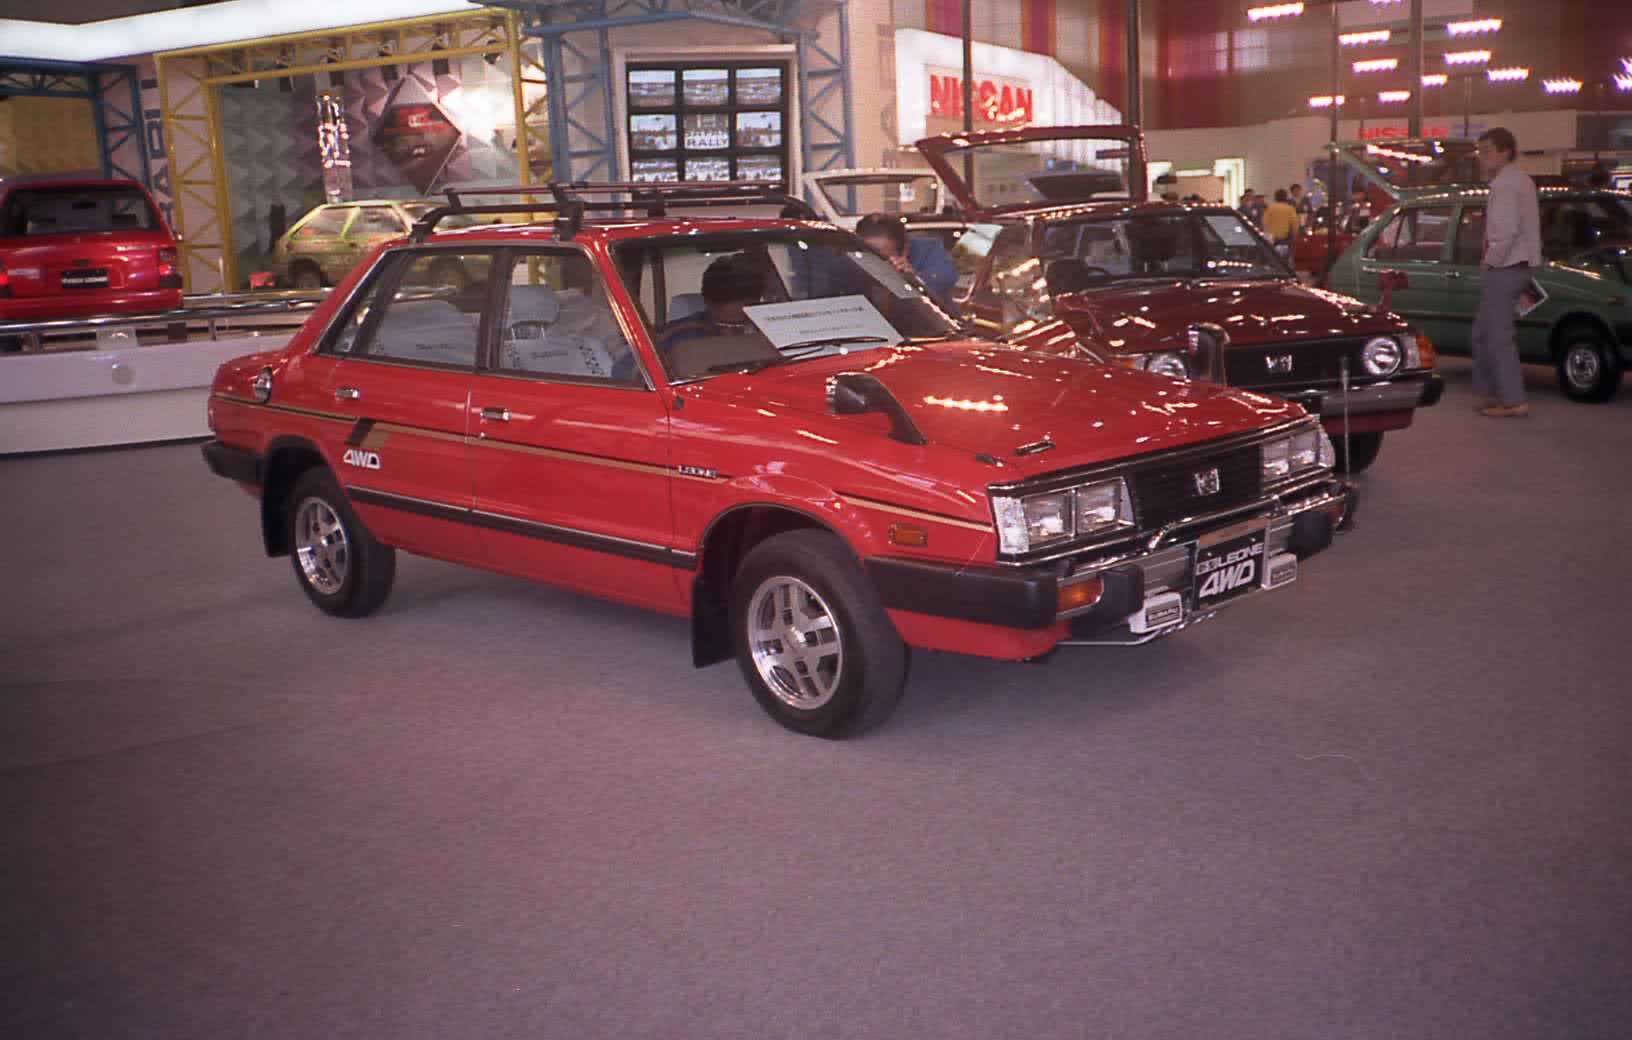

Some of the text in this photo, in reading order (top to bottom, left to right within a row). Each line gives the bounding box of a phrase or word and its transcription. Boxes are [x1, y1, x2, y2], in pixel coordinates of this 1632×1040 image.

[929, 74, 1033, 122] NISSAN
[343, 448, 381, 470] 4WD
[1217, 542, 1265, 567] LEONE
[1199, 558, 1255, 598] 4WD
